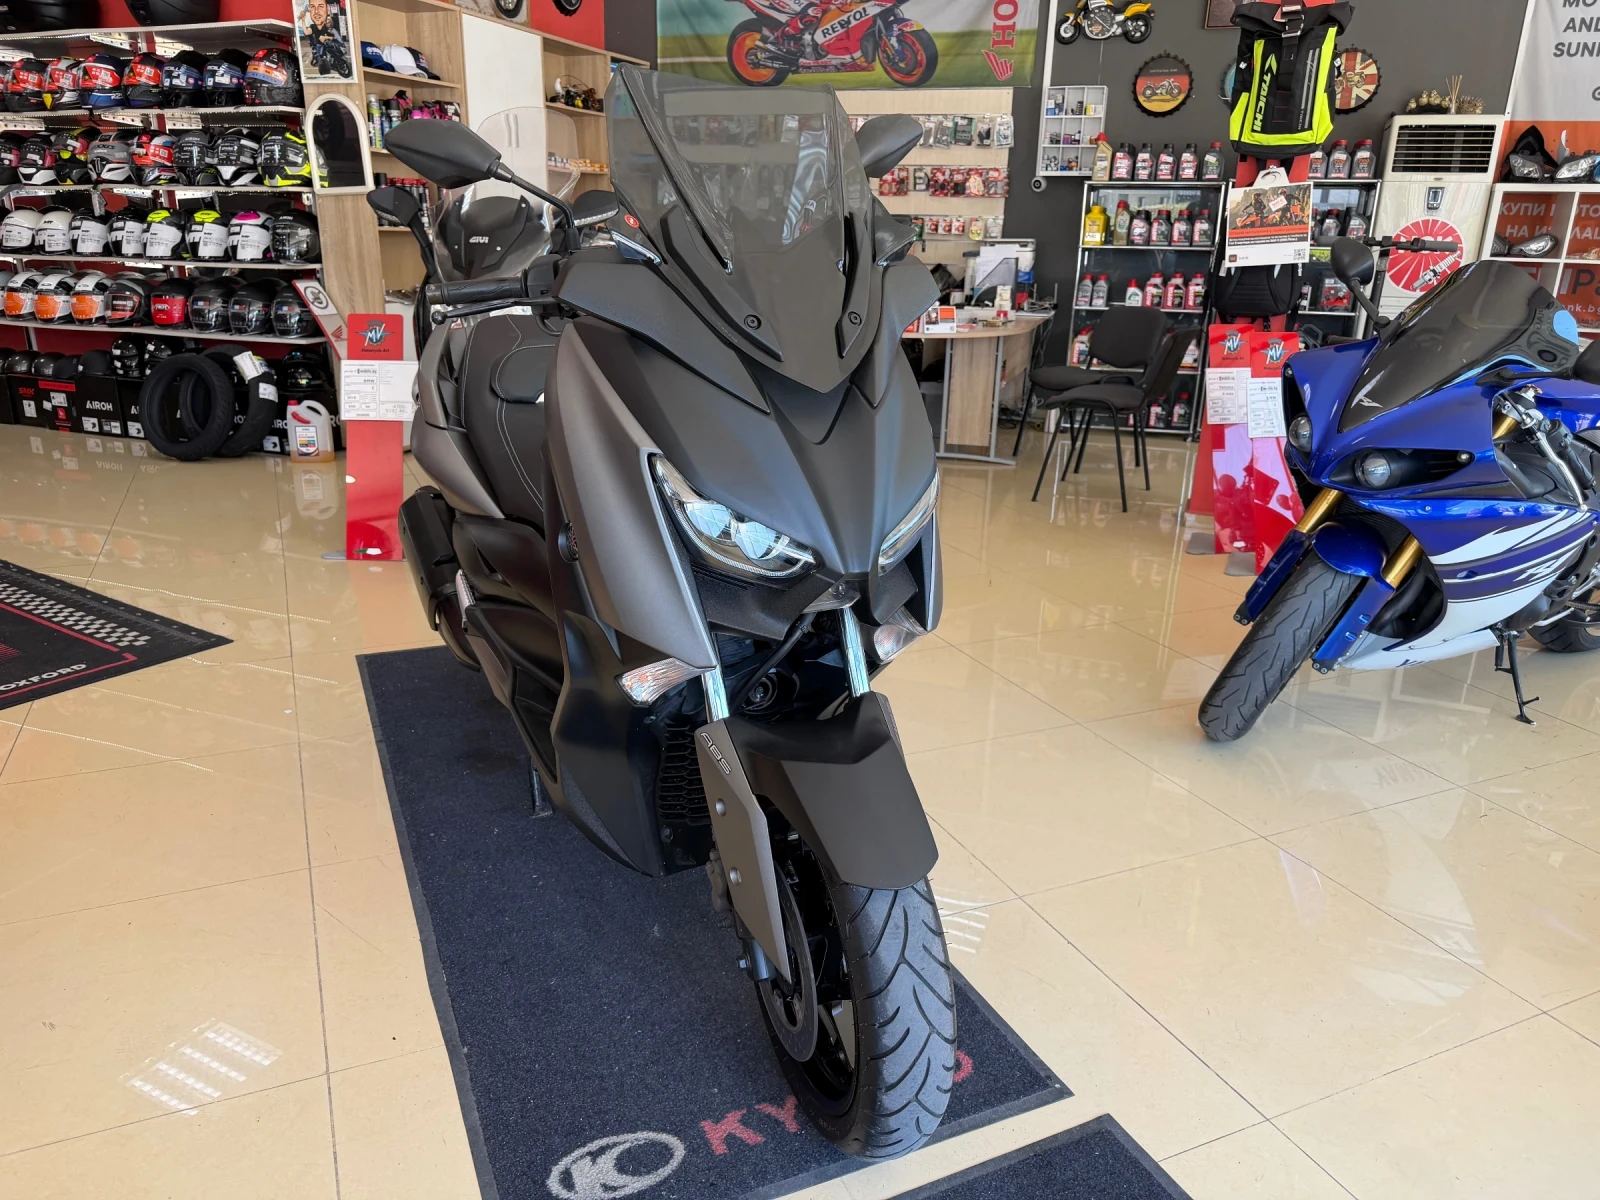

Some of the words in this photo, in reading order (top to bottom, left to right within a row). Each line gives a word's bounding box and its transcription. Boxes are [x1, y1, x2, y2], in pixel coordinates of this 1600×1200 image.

[1253, 73, 1271, 132] TAICHI
[1499, 202, 1545, 215] КУПИ
[1506, 226, 1528, 237] НА
[86, 400, 113, 411] AIROH
[0, 663, 87, 691] OXFORD
[700, 732, 732, 775] ABS
